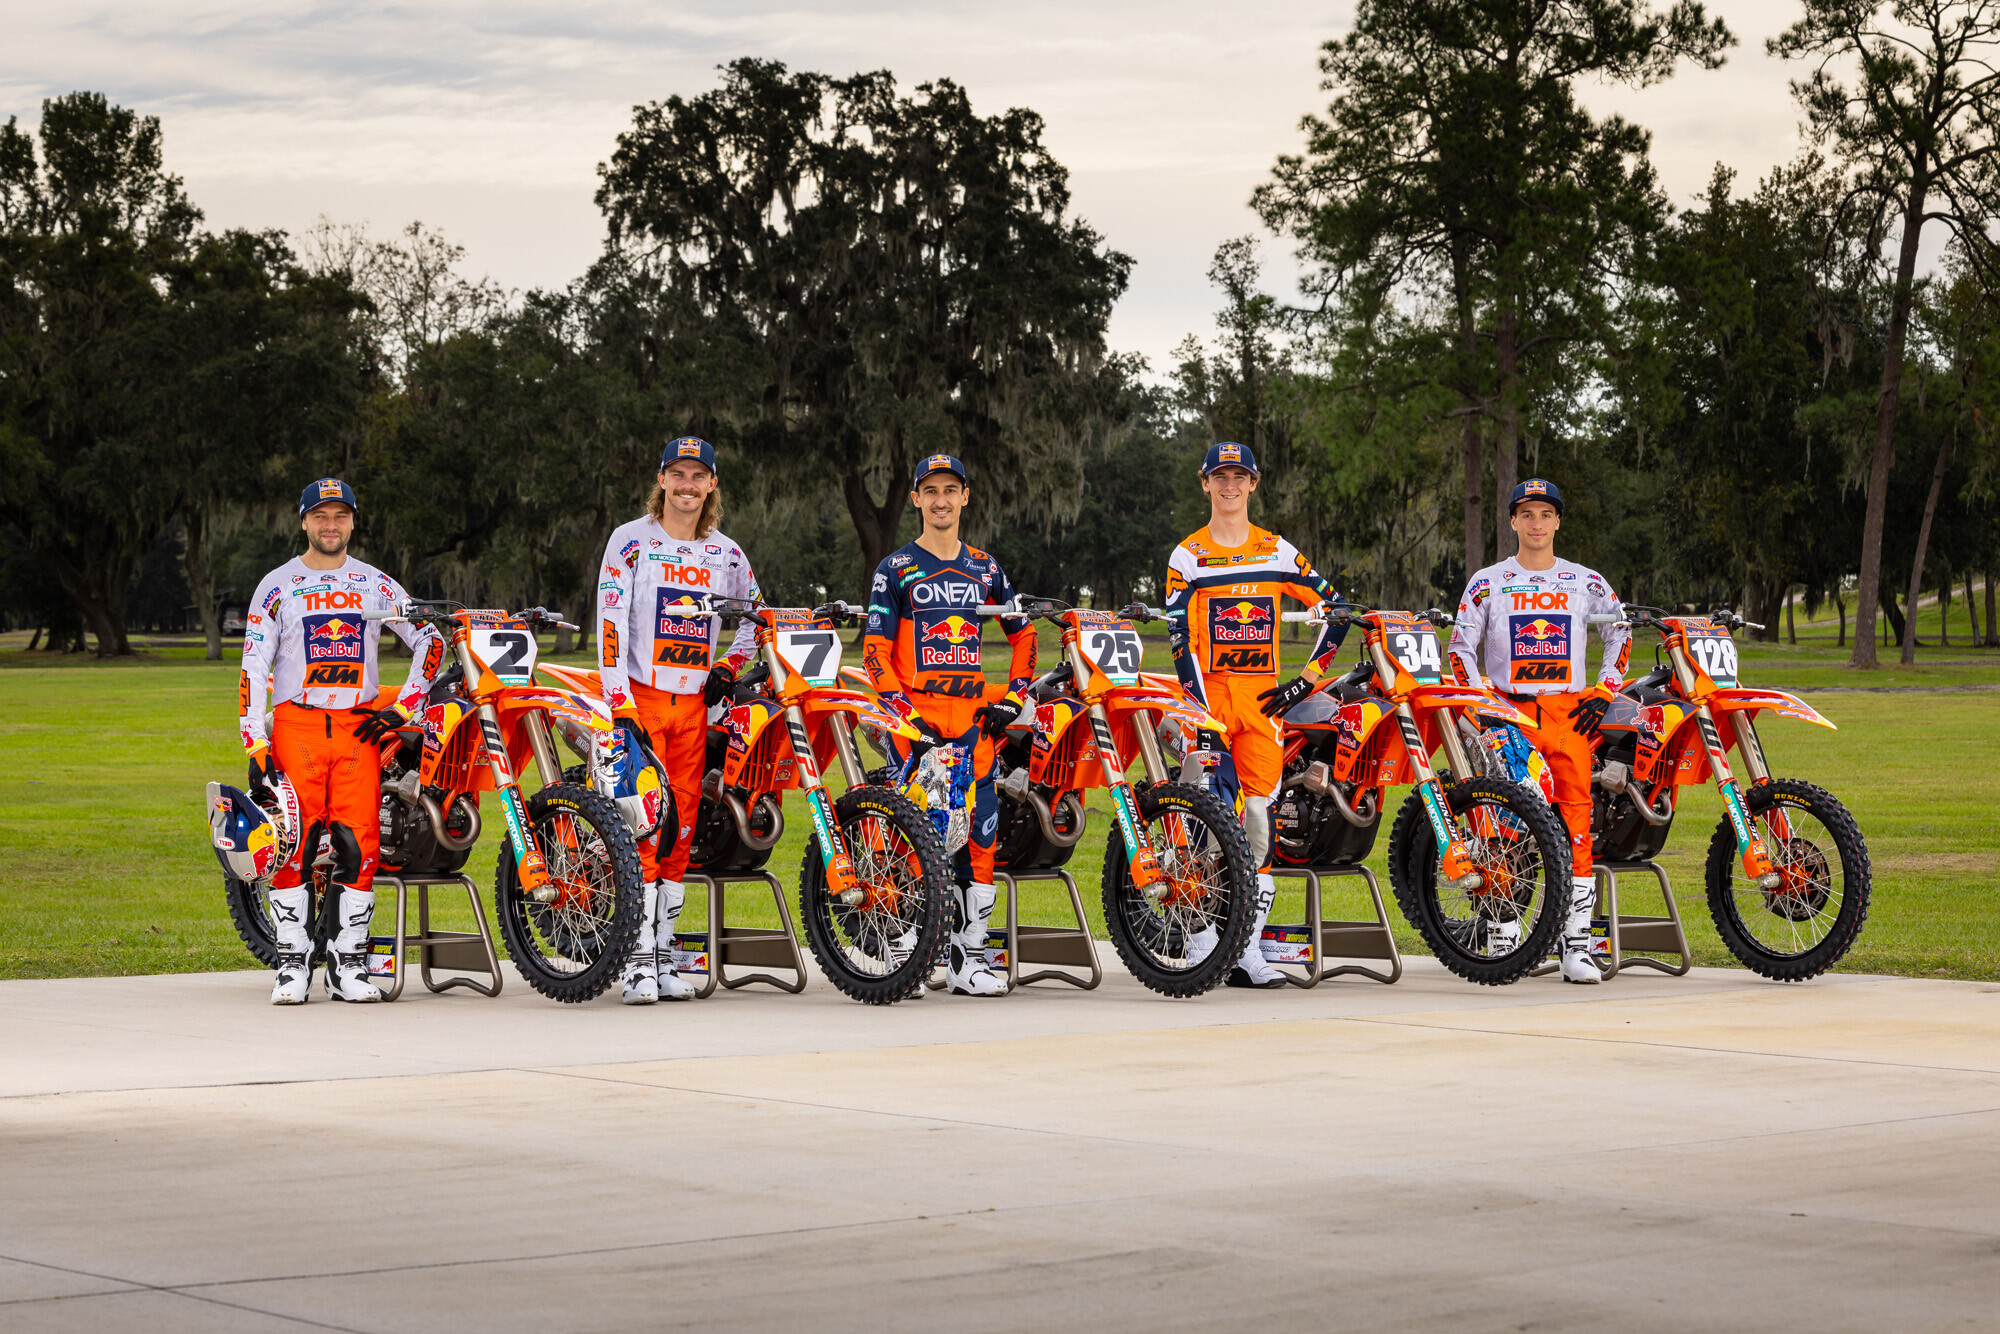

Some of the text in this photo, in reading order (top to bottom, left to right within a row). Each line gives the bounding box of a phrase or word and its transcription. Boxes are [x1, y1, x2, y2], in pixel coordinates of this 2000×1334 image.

[706, 546, 720, 554] 100%
[350, 573, 366, 581] 100%
[662, 562, 710, 588] THOR
[871, 572, 888, 593] 25
[303, 584, 329, 593] MOTOREX
[1231, 584, 1258, 595] FOX
[303, 591, 363, 611] THOR
[1511, 592, 1568, 610] THOR
[661, 619, 686, 635] Red
[1216, 625, 1270, 640] Red Bull
[310, 642, 361, 659] Red Bull
[603, 618, 619, 667] KTM
[1516, 641, 1566, 655] Red Bull
[422, 637, 443, 683] KTM
[489, 632, 529, 676] 2
[658, 643, 708, 667] KTM
[790, 633, 834, 677] 7
[922, 645, 981, 665] Red Bul
[1091, 632, 1140, 674] 25
[1216, 648, 1269, 667] KTM
[1395, 633, 1441, 673] 34
[1691, 638, 1737, 677] 128
[307, 665, 359, 685] KTM
[1514, 662, 1568, 680] KTM
[923, 674, 985, 698] KTM
[1284, 680, 1306, 701] FOX
[1201, 733, 1211, 750] FO
[423, 751, 435, 762] KTM
[728, 751, 740, 762] KTM
[937, 748, 951, 756] Bull
[1032, 750, 1044, 760] KTM
[1338, 749, 1351, 759] KTM
[1638, 749, 1652, 759] KTM
[546, 799, 579, 810] DUNLOP
[1158, 797, 1193, 807] DUNLOP
[1471, 792, 1509, 802] DUNLOP
[1773, 793, 1812, 807] DUNLOP
[281, 782, 298, 844] Red Bull
[860, 802, 894, 816] DUNLOP
[505, 811, 524, 853] MOTOREX
[1117, 808, 1137, 850] MOTOREX
[1427, 803, 1449, 844] MOTOREX
[1728, 803, 1748, 843] MOTOREX
[218, 839, 233, 847] BELL
[813, 813, 832, 856] MOTOREX
